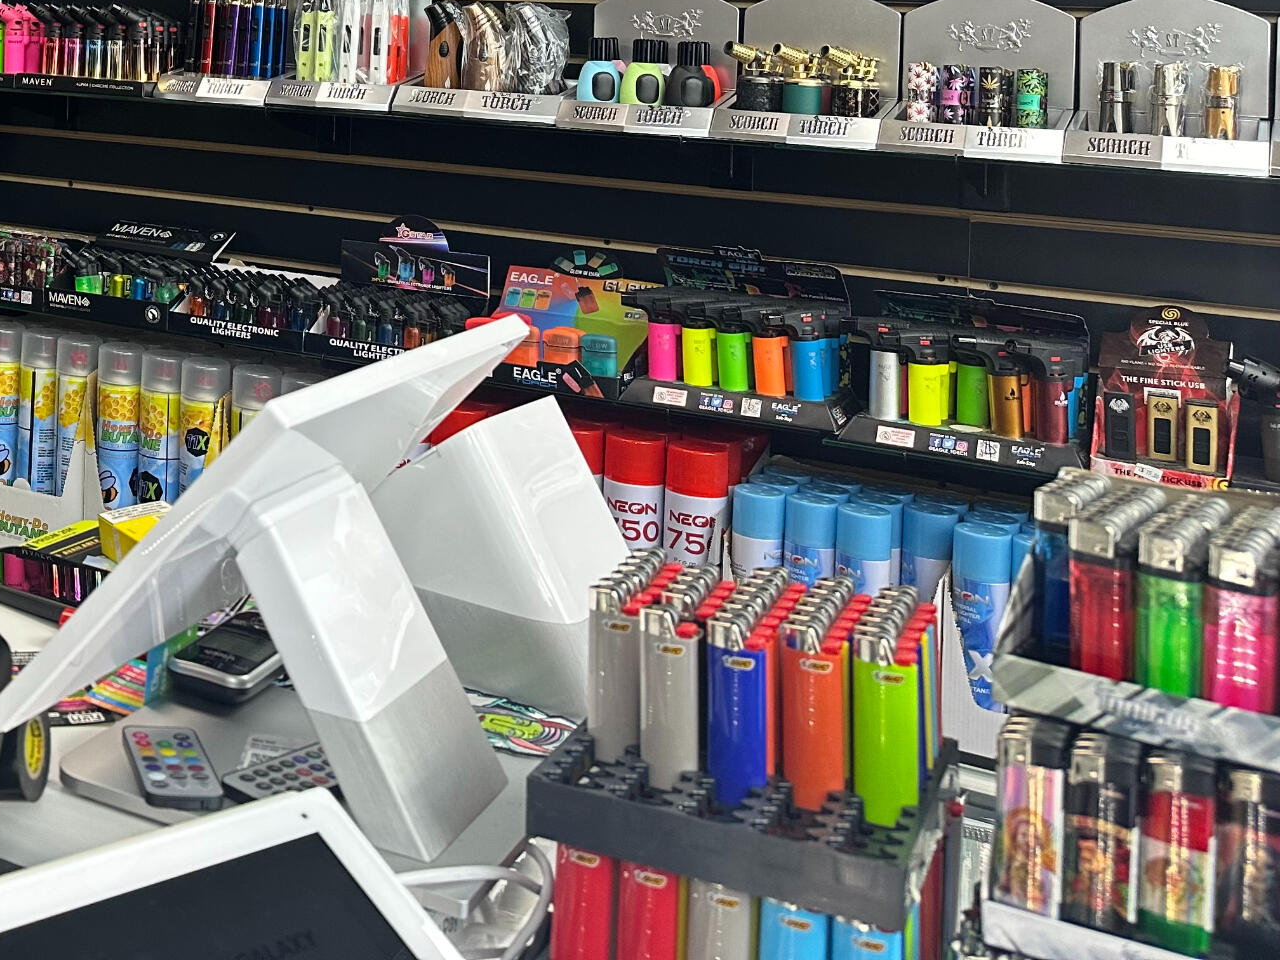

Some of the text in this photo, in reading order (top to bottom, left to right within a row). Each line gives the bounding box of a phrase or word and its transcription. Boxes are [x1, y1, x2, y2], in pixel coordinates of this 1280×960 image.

[22, 77, 52, 86] MAVEN
[408, 88, 532, 111] SCORCH TORCH
[573, 106, 620, 121] SCORCH
[729, 115, 848, 136] SCORCH TORCH
[899, 126, 955, 143] SCORCH
[1088, 137, 1151, 155] SCORCH
[112, 223, 162, 237] MAVEN
[510, 271, 553, 285] EAGLE
[49, 292, 81, 306] MAVEN
[191, 316, 279, 337] QUALITY ELECTRONIC
[329, 339, 370, 353] QUALITY
[1148, 345, 1185, 354] LIGHTERS
[513, 367, 557, 383] EAGLE
[514, 377, 558, 389] TORCH
[1161, 379, 1186, 388] STICK
[771, 402, 798, 413] EAGLE
[607, 498, 658, 516] NEON
